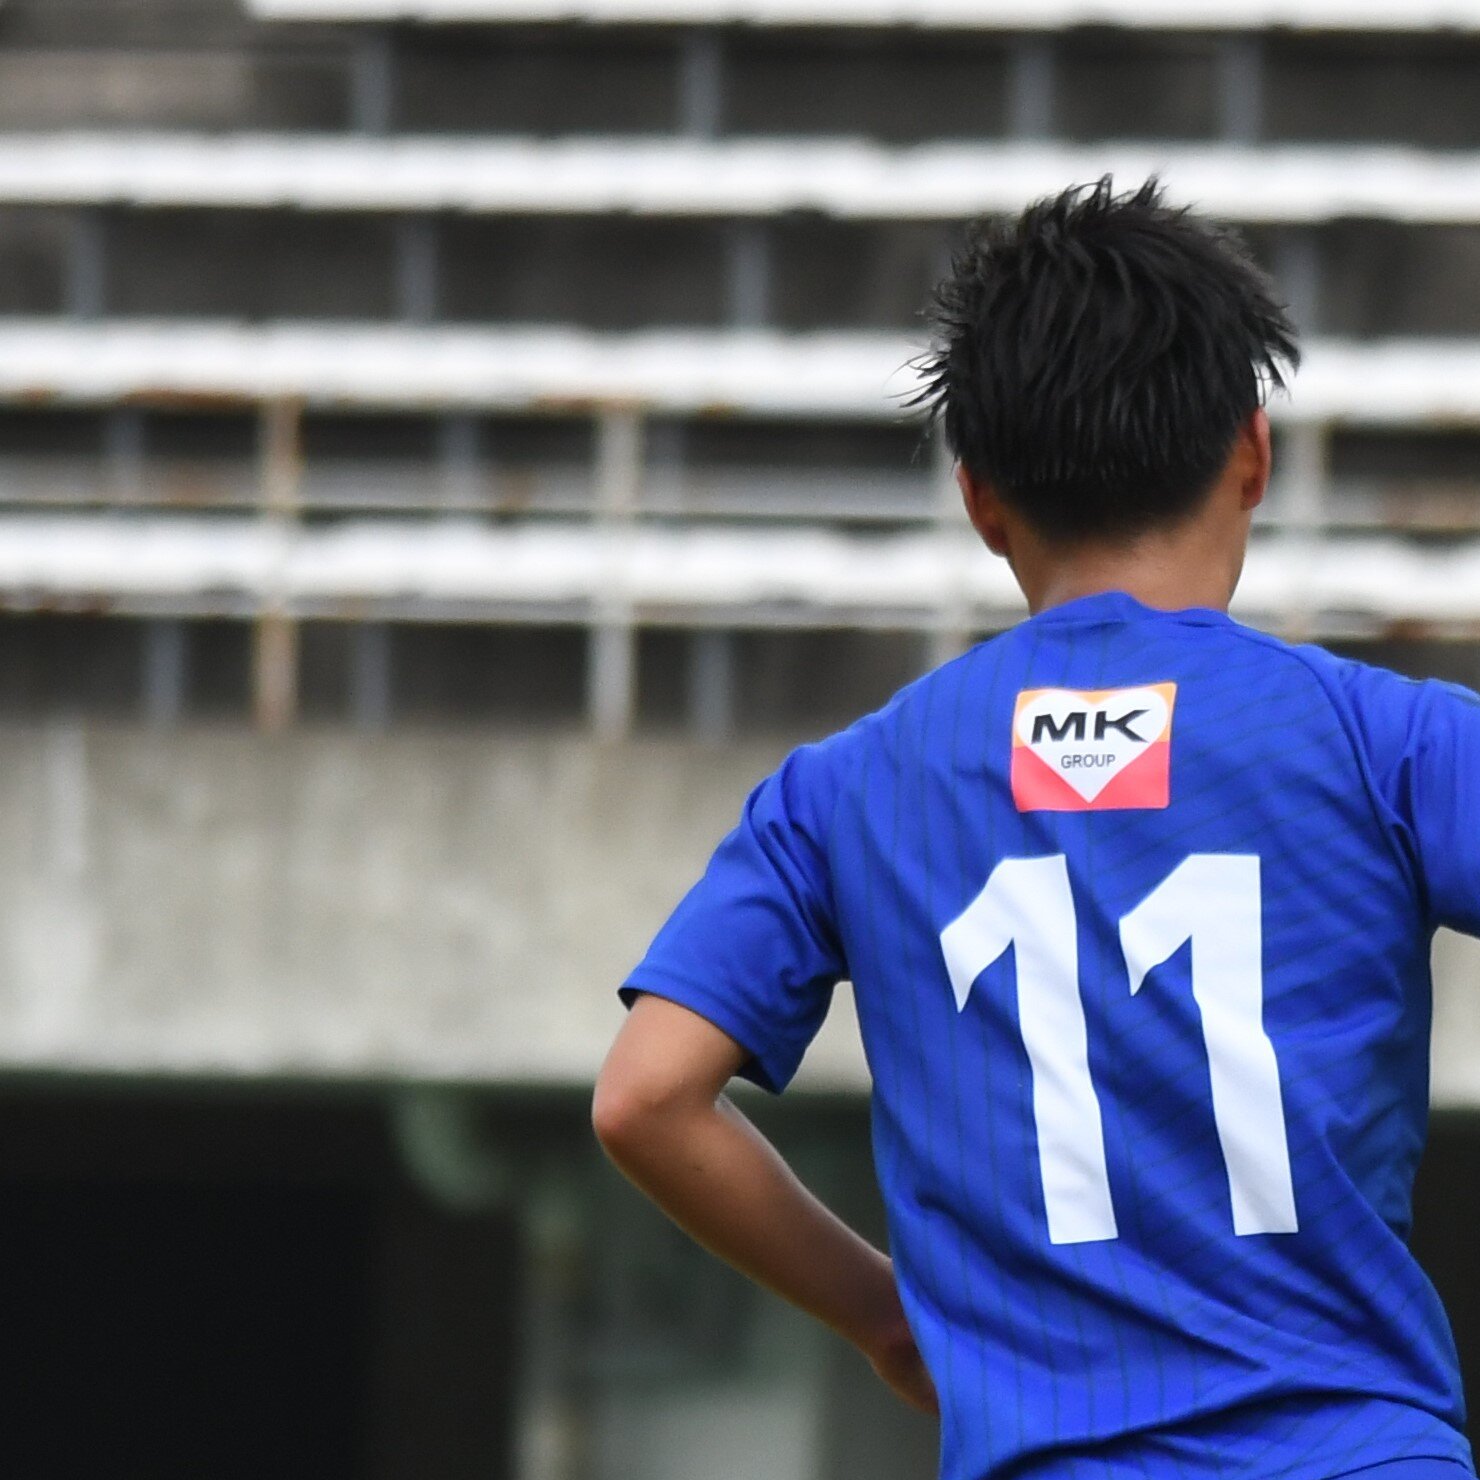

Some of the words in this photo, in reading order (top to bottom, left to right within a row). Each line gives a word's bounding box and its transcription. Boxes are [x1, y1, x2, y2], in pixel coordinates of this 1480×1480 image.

[1031, 709, 1151, 744] MK
[1060, 753, 1116, 769] GROUP
[940, 853, 1299, 1245] 11
